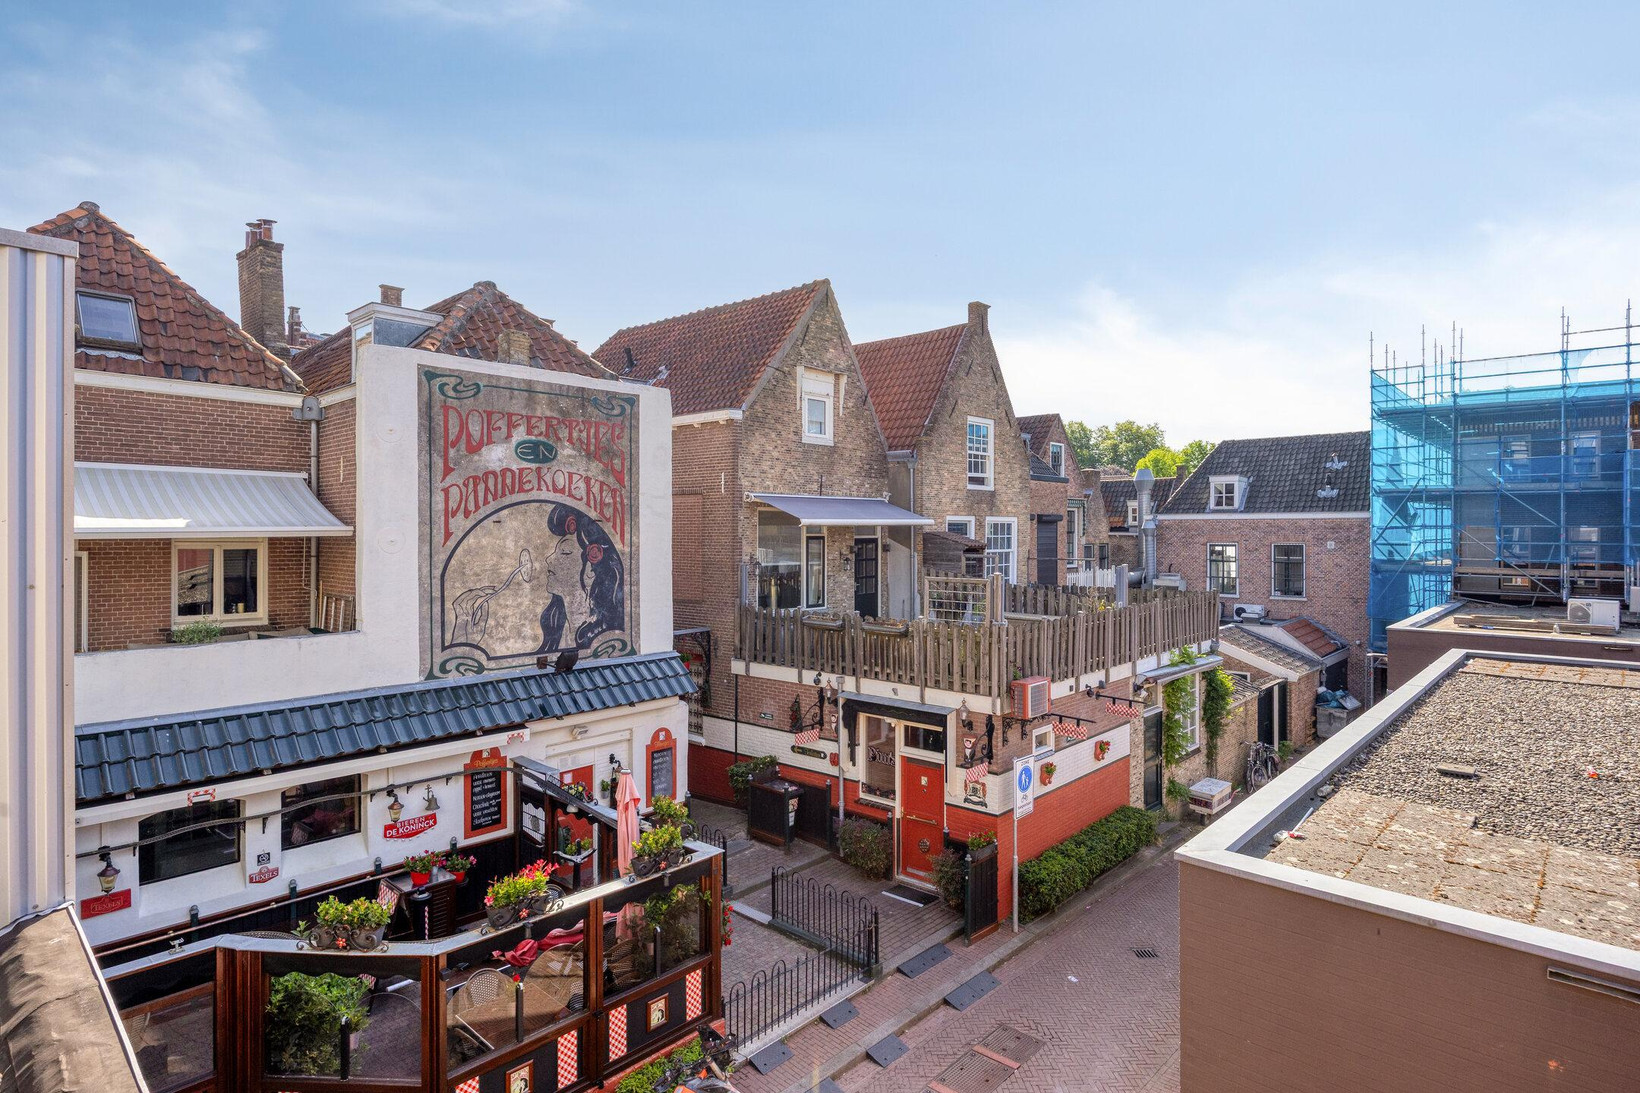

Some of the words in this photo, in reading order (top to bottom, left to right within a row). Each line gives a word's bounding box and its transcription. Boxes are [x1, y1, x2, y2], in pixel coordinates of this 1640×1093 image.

[440, 404, 626, 489] POFFERTJES
[517, 443, 556, 460] EN
[440, 466, 625, 549] PANNEKOEKEN
[386, 828, 398, 837] DE
[398, 818, 435, 835] KONINCK
[396, 816, 426, 828] BIEREN
[250, 870, 278, 883] TEXELS
